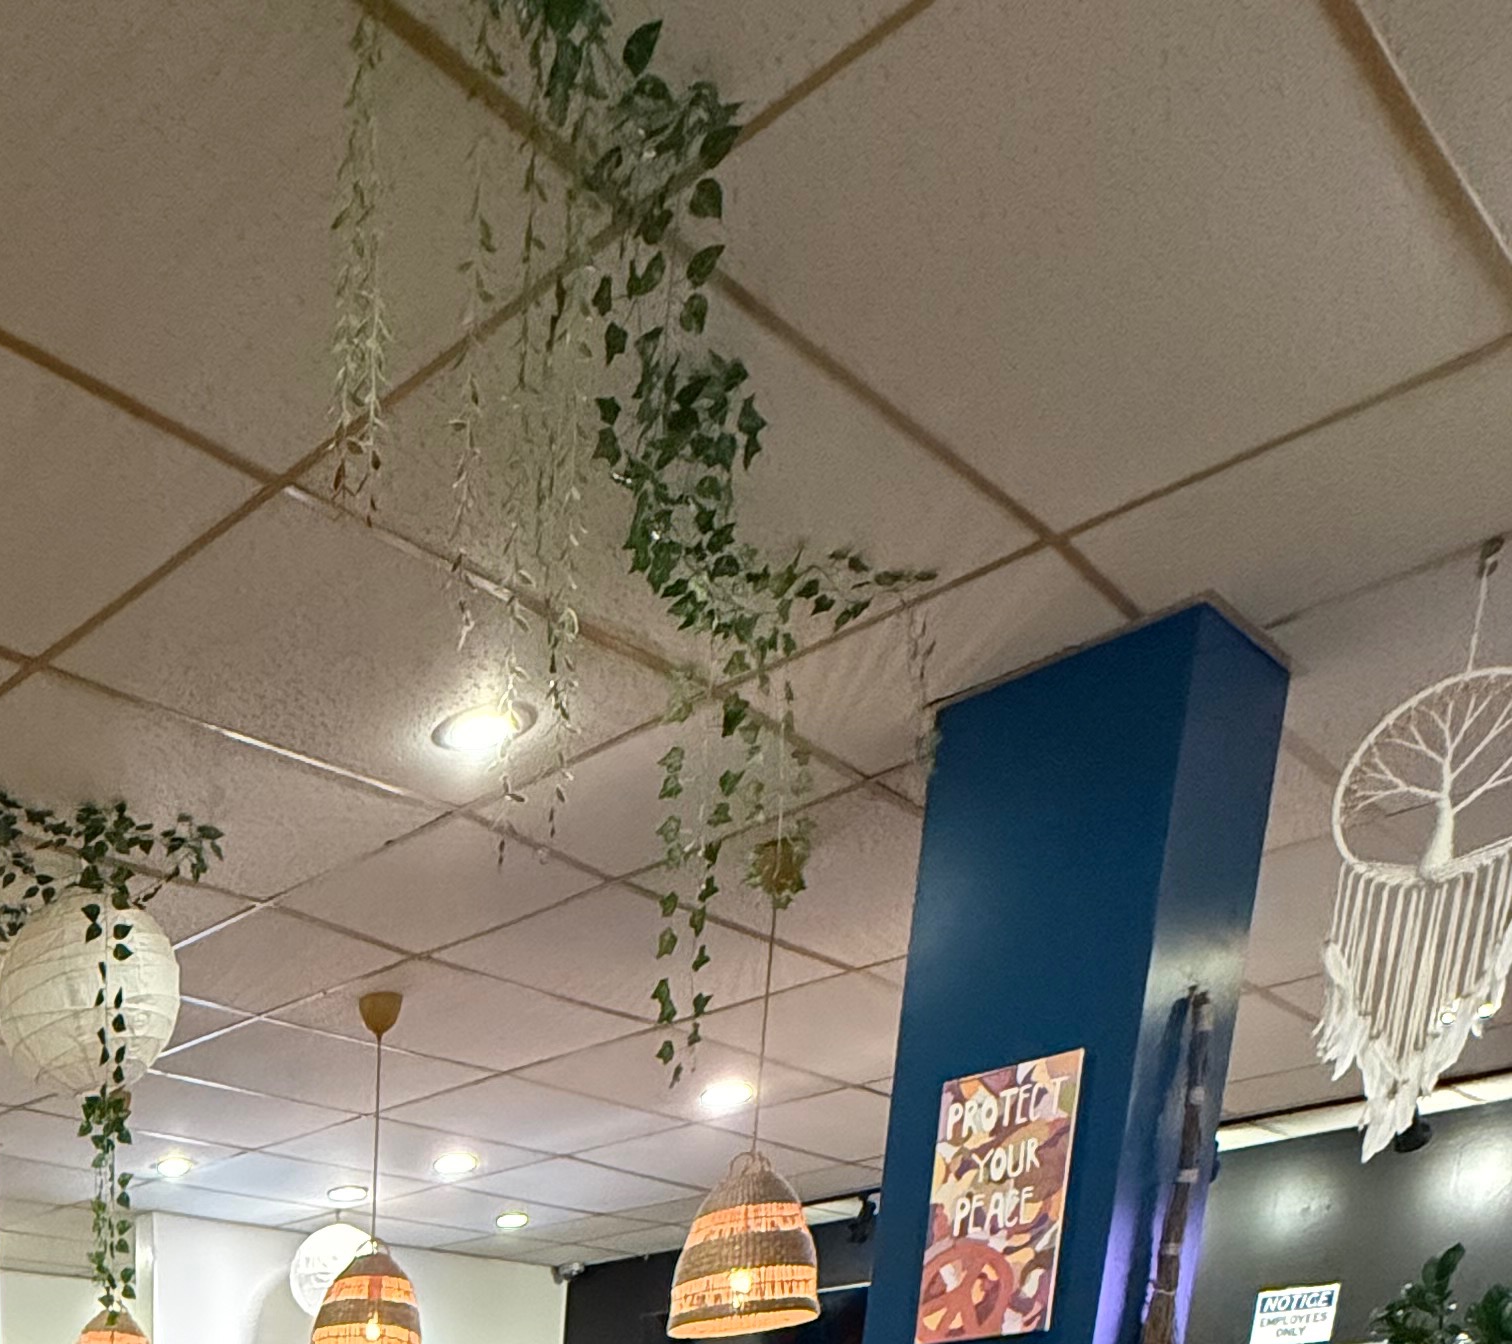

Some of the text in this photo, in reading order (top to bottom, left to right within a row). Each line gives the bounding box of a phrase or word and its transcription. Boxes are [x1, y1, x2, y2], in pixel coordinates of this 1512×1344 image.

[946, 1076, 1070, 1141] PROTECT
[971, 1138, 1040, 1183] YOUR
[952, 1186, 1035, 1237] PEACE
[1263, 1290, 1332, 1312] NOTICE
[1259, 1312, 1328, 1328] EMPLOYEES
[1276, 1326, 1307, 1338] ONLY
